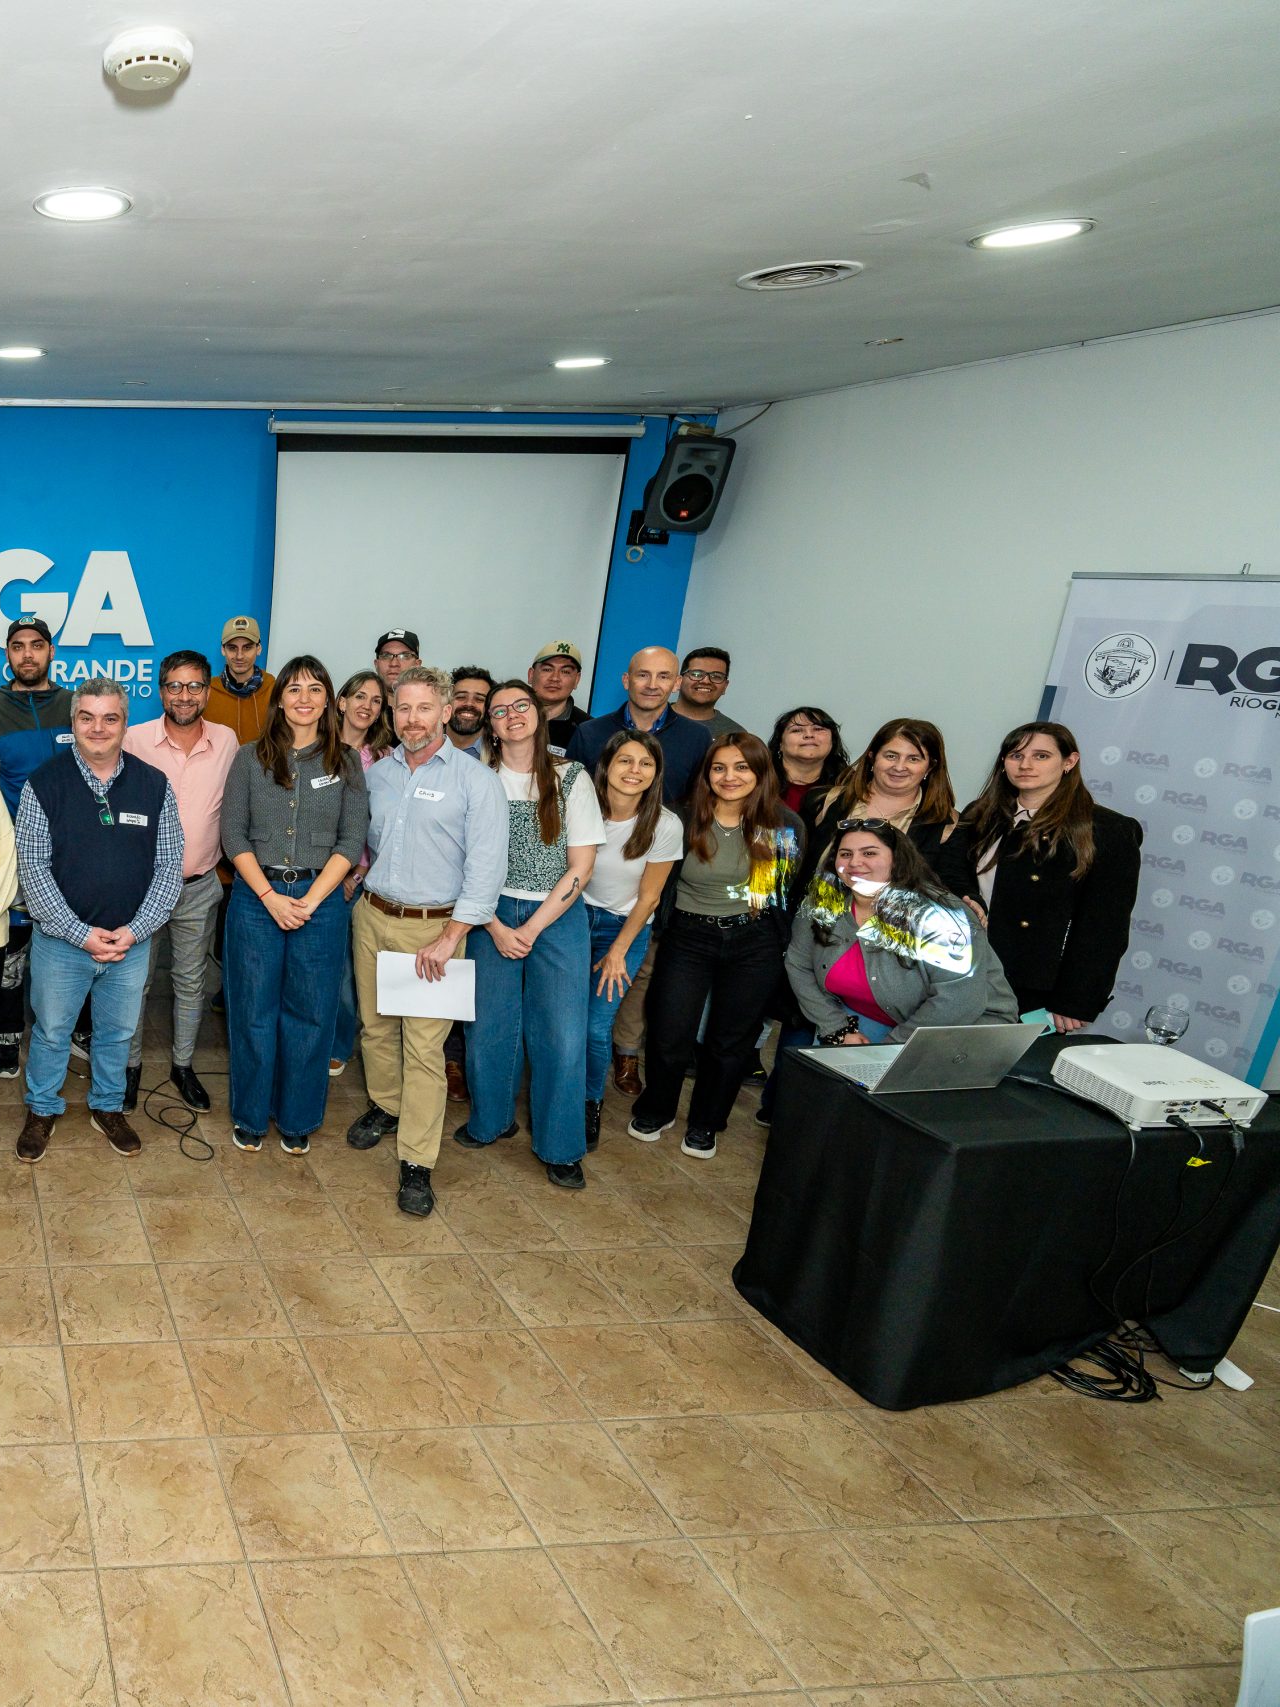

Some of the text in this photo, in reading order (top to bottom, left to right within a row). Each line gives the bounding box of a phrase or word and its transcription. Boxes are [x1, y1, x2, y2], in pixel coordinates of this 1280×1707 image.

[1176, 643, 1280, 695] RG
[1126, 750, 1170, 768] RGA
[1223, 762, 1272, 781] RGA
[1088, 779, 1113, 793] GA
[1161, 789, 1208, 808] RGA
[1199, 830, 1249, 850] RGA
[1179, 894, 1225, 915] RGA
[1217, 937, 1265, 960] RGA
[1157, 957, 1203, 979] RGA
[1117, 980, 1143, 997] GA
[1194, 1000, 1241, 1024] RGA
